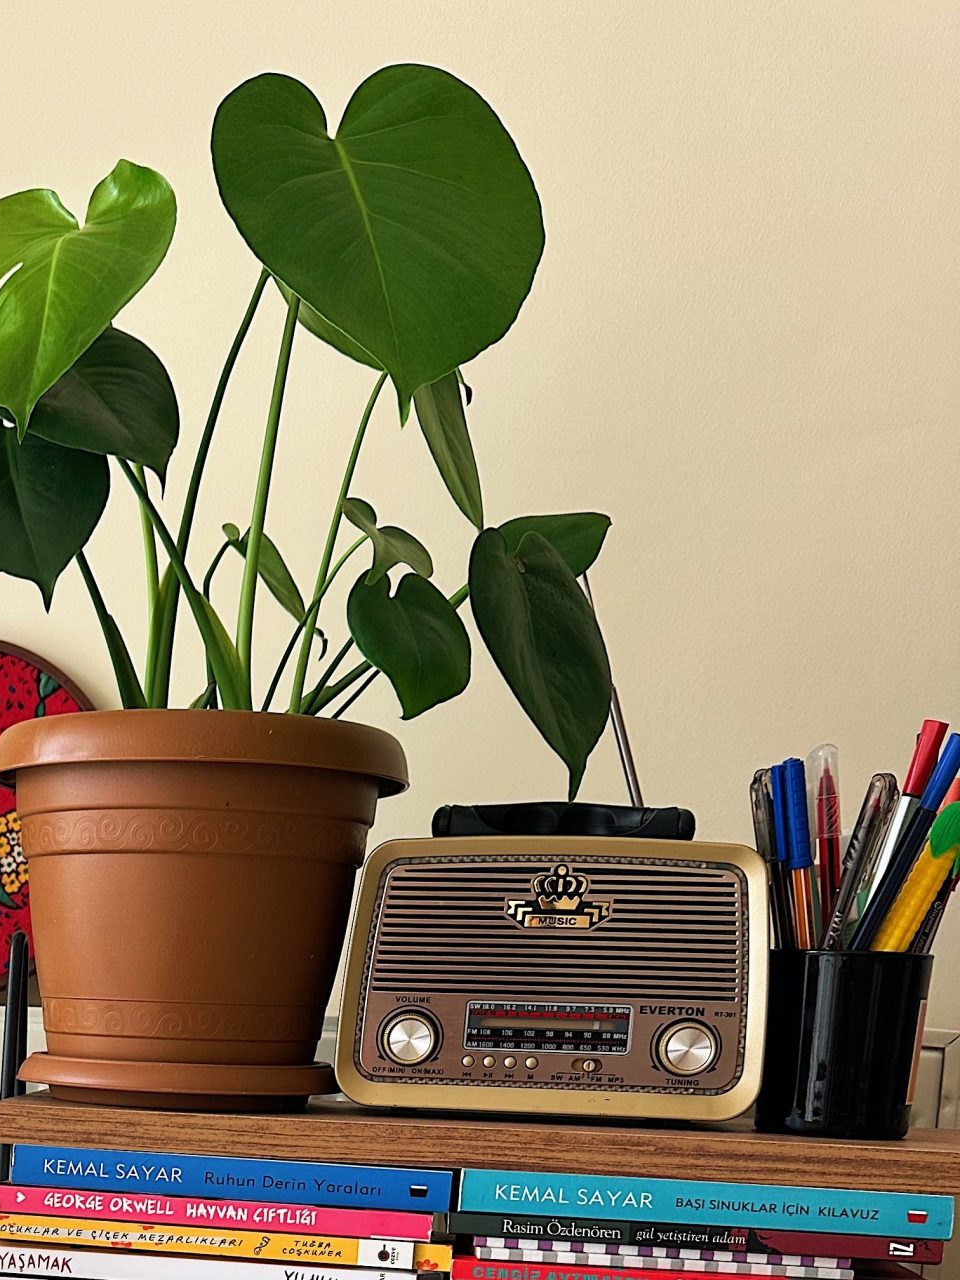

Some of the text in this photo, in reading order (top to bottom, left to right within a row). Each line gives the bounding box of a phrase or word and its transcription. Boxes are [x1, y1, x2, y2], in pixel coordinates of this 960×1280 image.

[538, 917, 576, 926] MUSIC
[640, 1005, 705, 1016] EVERTON
[44, 1159, 381, 1196] KEMAL SAYAR Ruhun Derin Yaraları
[44, 1192, 247, 1221] GEORGE ORWELL HAYVAN
[495, 1184, 879, 1220] KEMAL SAYAR BAŞI SINUKLAR İÇİN KILAVUZ
[502, 1219, 746, 1244] Rasim Özdenören gül yetiştiren adam
